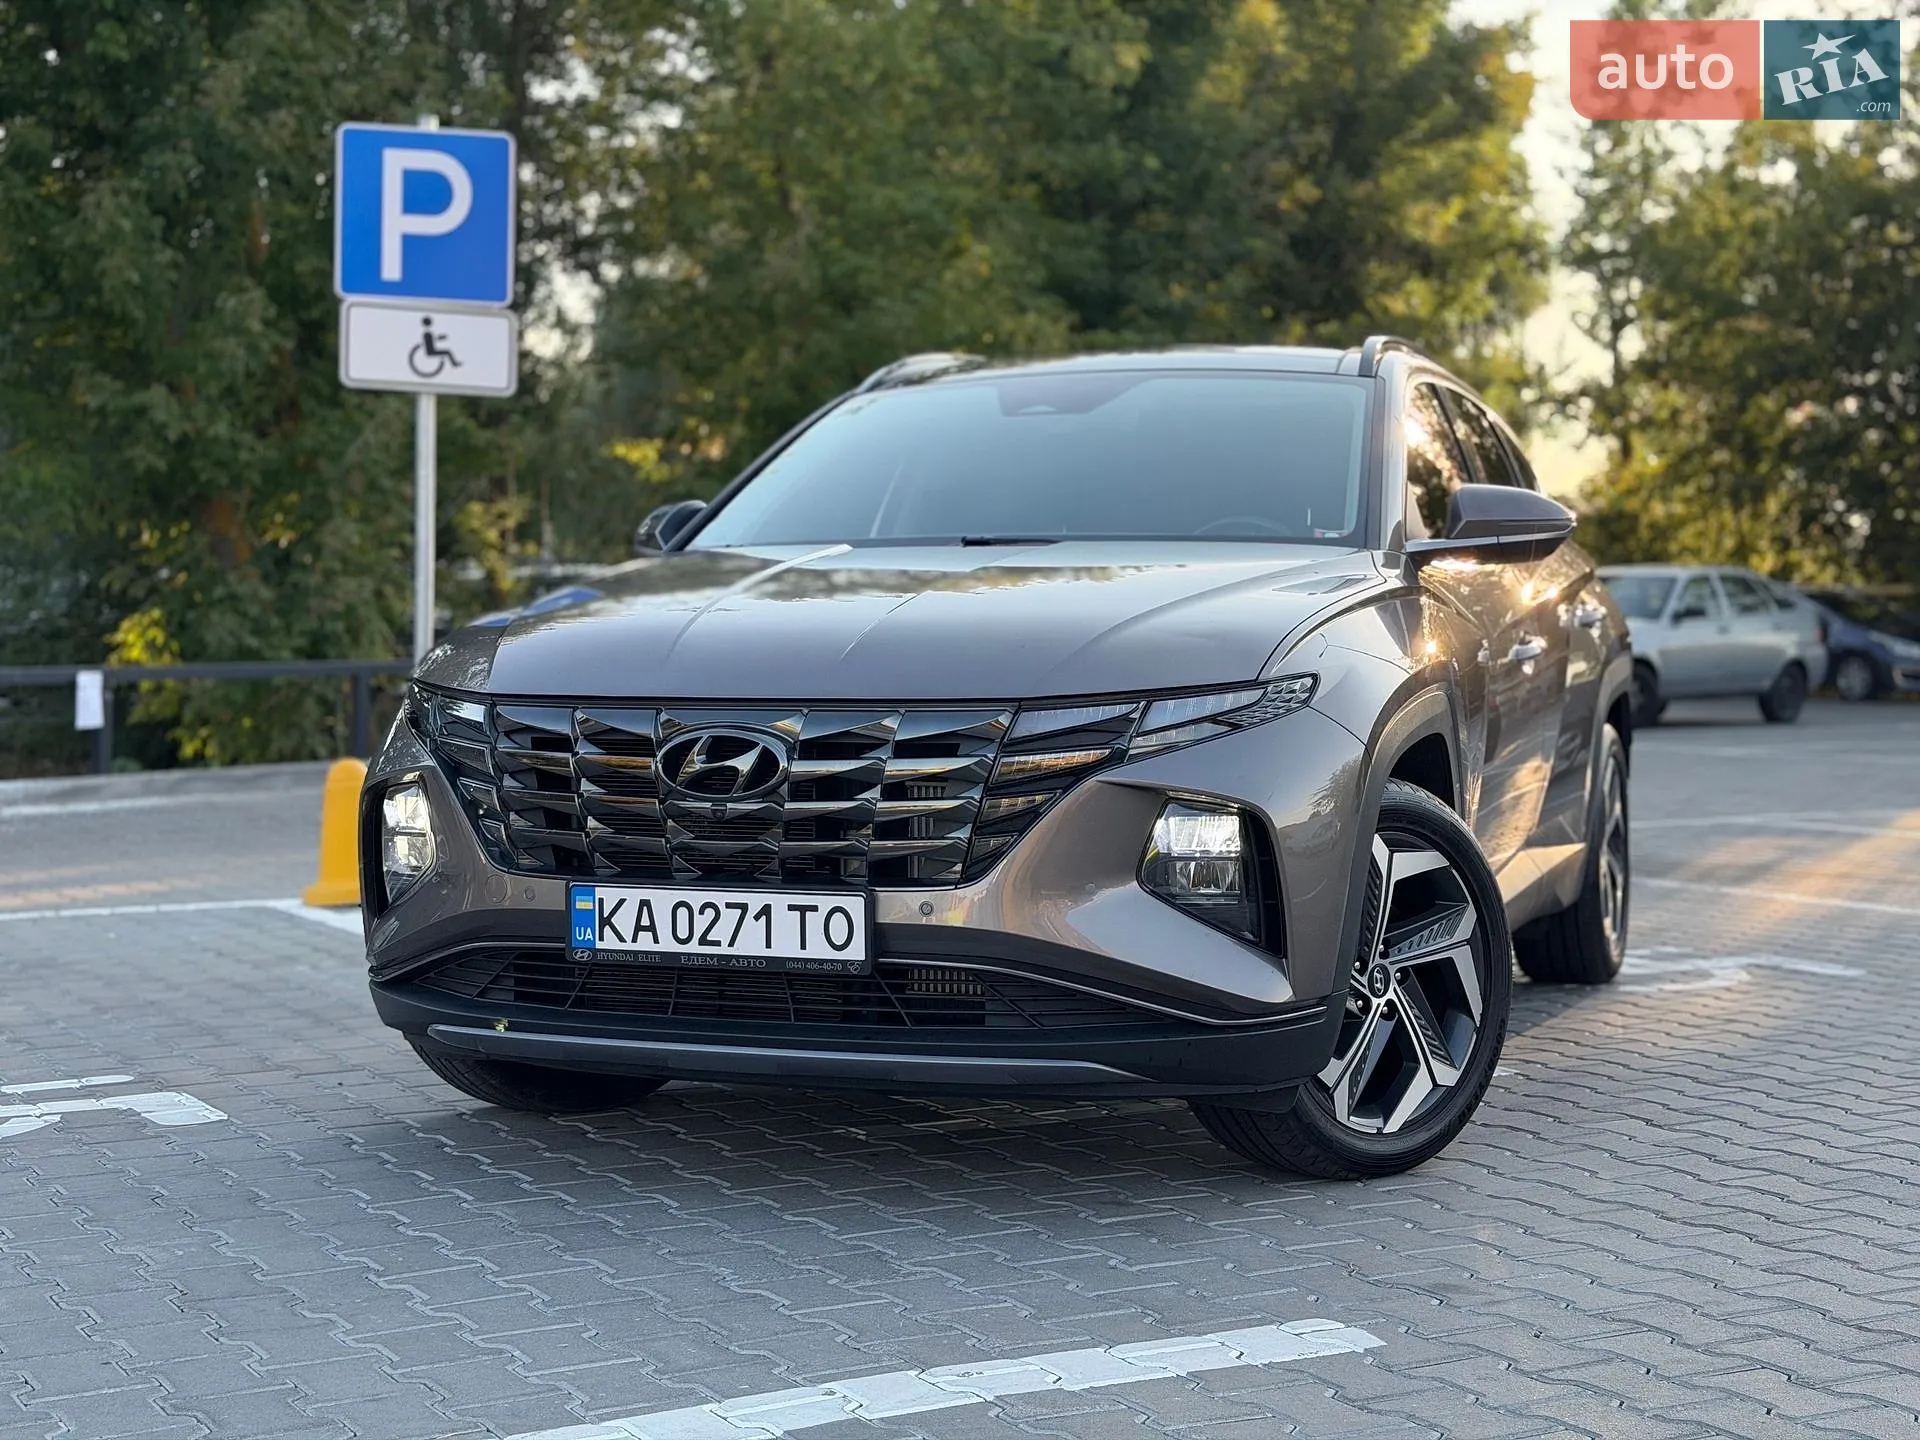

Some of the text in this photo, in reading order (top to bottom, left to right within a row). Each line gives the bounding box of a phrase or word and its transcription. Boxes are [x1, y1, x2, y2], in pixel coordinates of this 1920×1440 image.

[380, 147, 473, 282] P
[597, 897, 855, 952] KA 0271 TO
[576, 926, 593, 941] UA
[597, 951, 661, 963] HYUNDAI ELITE
[680, 955, 720, 967] ЕДЕМ
[729, 957, 766, 968] АВТО
[786, 960, 843, 971] (044) 406-40-70
